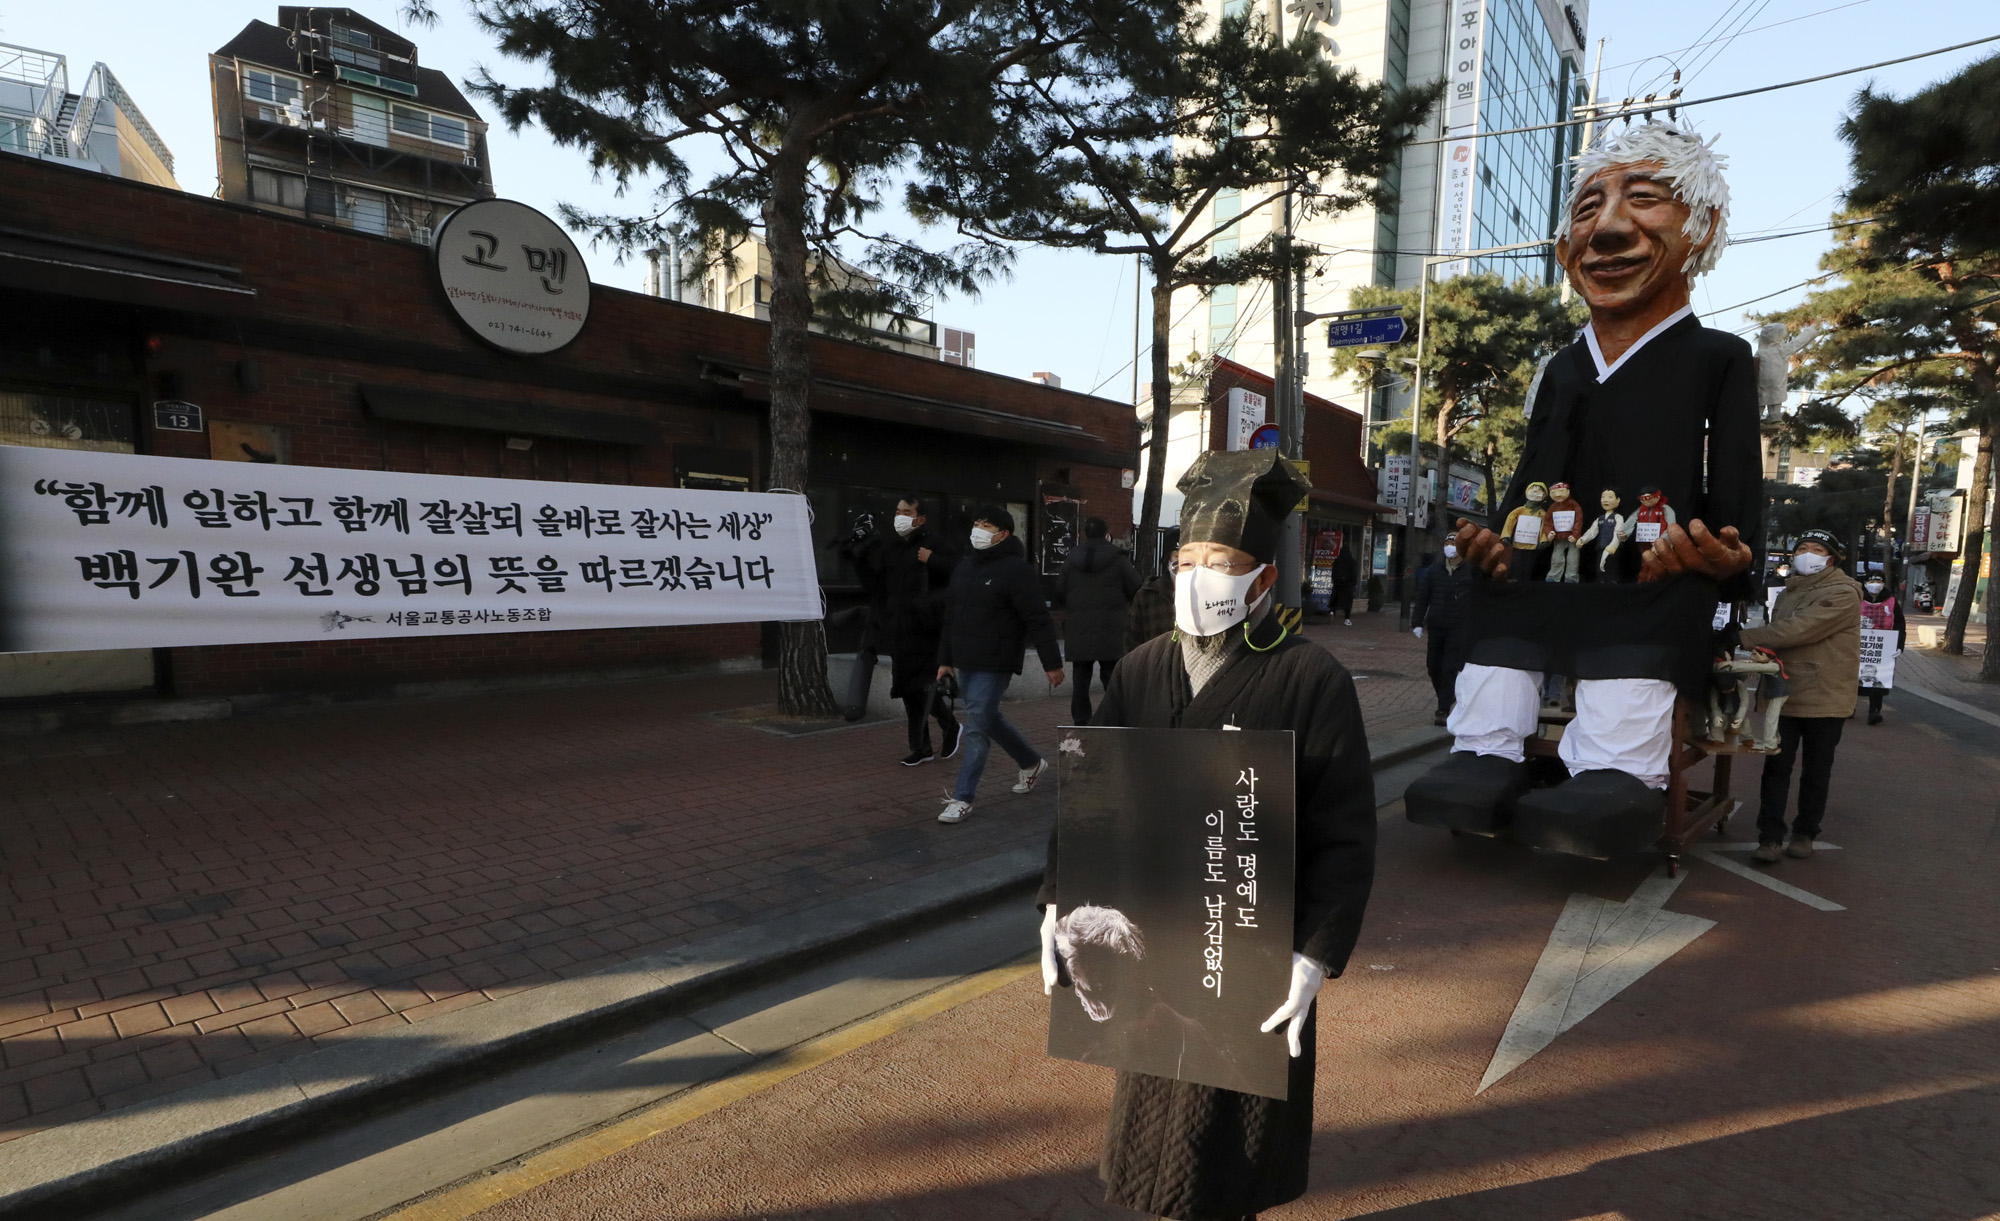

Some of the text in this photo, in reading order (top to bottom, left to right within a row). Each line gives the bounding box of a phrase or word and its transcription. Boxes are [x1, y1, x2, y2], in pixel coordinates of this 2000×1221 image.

[1457, 10, 1478, 100] 후아이엠
[488, 321, 553, 339] 02) 741-6645
[1330, 323, 1363, 336] 대명1길
[1330, 334, 1385, 346] Daemyeong 1-gil
[1243, 391, 1263, 408] 숯불갈비
[169, 414, 190, 428] 13
[1386, 475, 1399, 505] 돼지갈비
[34, 478, 168, 528] “함께
[183, 488, 322, 531] 일하고
[328, 496, 410, 534] 함께
[419, 499, 523, 537] 잘살되
[532, 503, 625, 540] 올바로
[631, 508, 711, 541] 잘사는
[74, 549, 774, 599] 백기완 선생님의 뜻을 따르겠습니다
[386, 607, 552, 627] 서울교통공사노동조합
[1216, 607, 1236, 617] 세상
[1235, 767, 1259, 928] 사랑도 명예도
[1202, 809, 1227, 998] 이름도 남김없이
